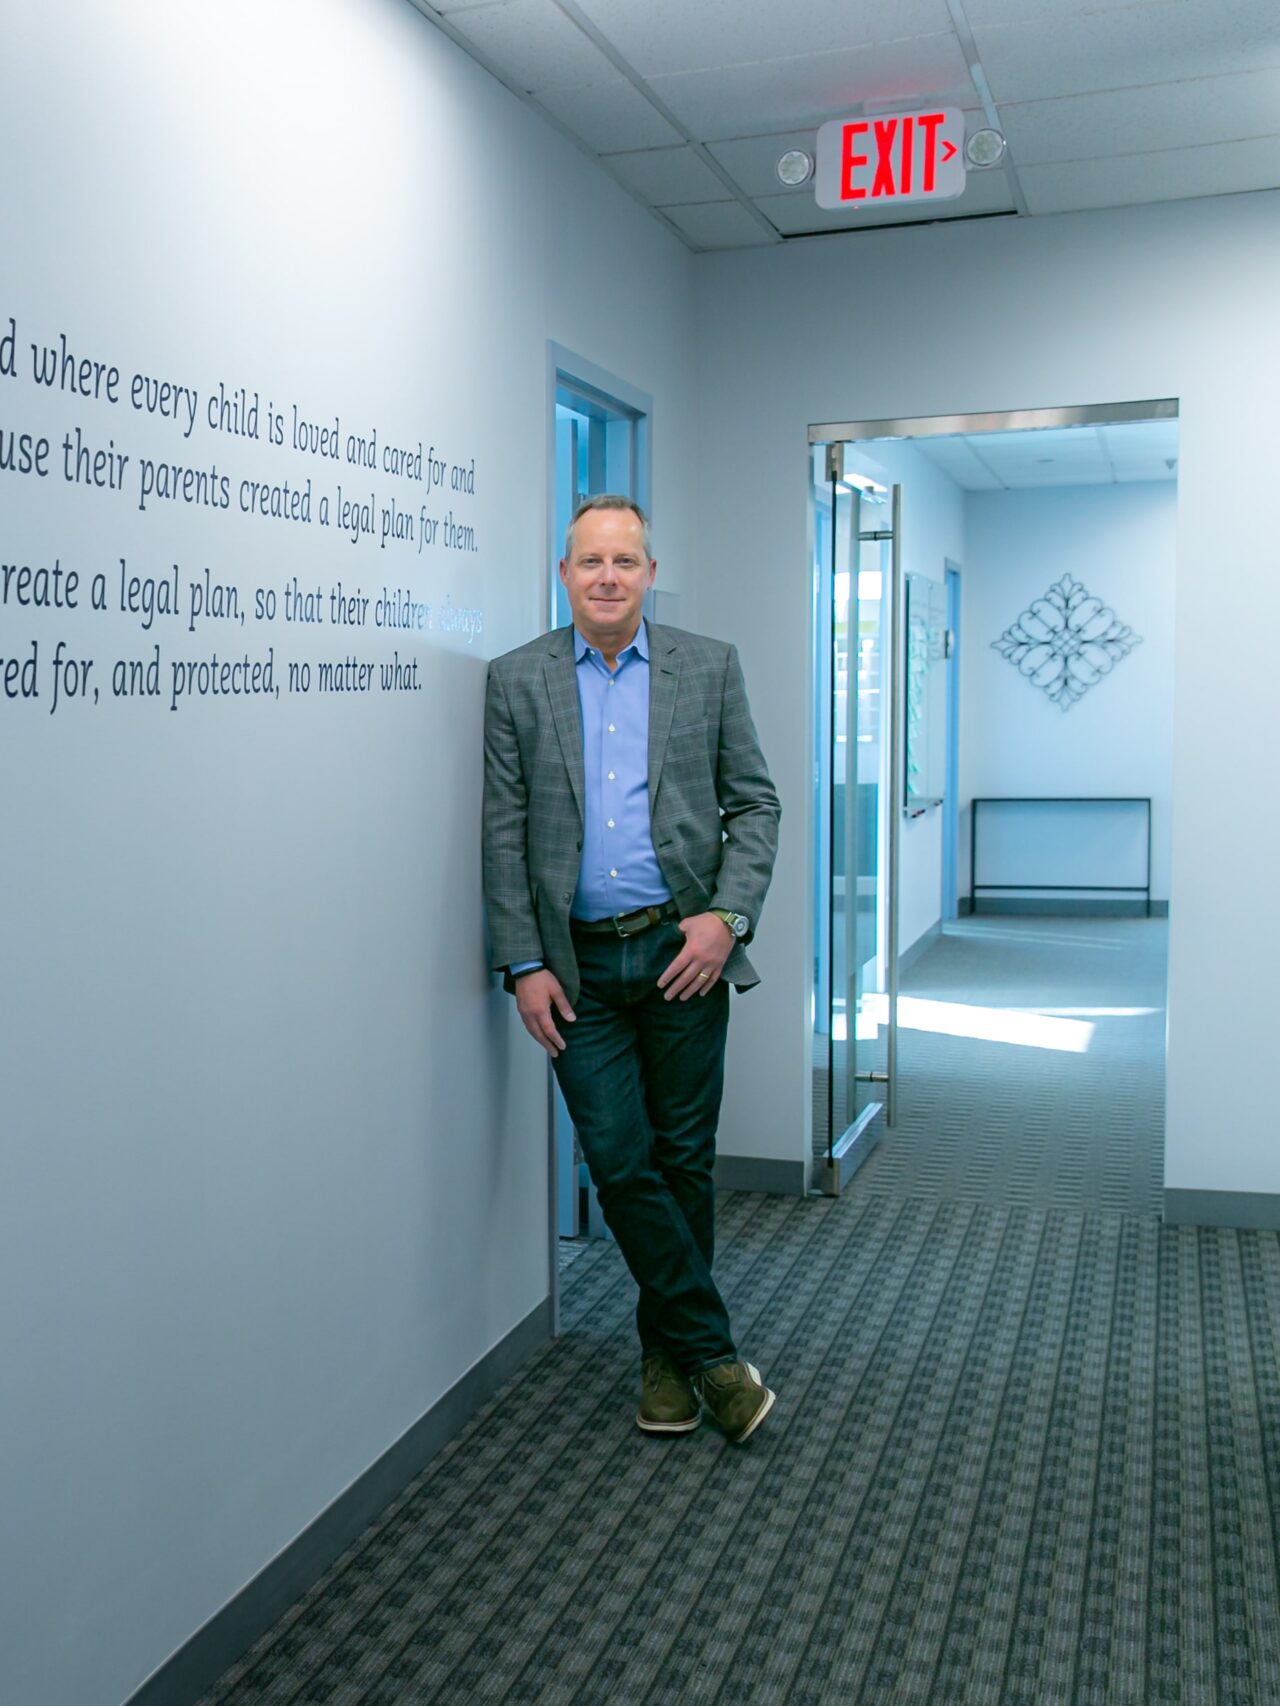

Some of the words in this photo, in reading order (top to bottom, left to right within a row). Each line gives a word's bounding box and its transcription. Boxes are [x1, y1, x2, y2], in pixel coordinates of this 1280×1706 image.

[841, 114, 945, 201] EXIT
[31, 333, 119, 403] where
[131, 374, 197, 438] every
[208, 382, 259, 440] child
[268, 402, 283, 446] is
[293, 404, 339, 460] loved
[347, 428, 376, 469] and
[383, 442, 422, 481] cared
[427, 447, 446, 495] for
[451, 459, 474, 495] and
[62, 427, 129, 490] their
[139, 459, 229, 511] parents
[240, 479, 311, 523] created
[319, 497, 329, 526] a
[337, 485, 375, 544] legal
[381, 498, 414, 549] plan
[418, 505, 438, 554] for
[444, 511, 478, 551] them.
[91, 574, 107, 610] a
[120, 558, 179, 630] legal
[189, 568, 244, 632] plan,
[255, 588, 276, 620] so
[285, 577, 322, 623] that
[330, 582, 369, 626] their
[375, 587, 433, 630] children
[50, 641, 99, 715] for,
[112, 644, 160, 696] and
[170, 647, 279, 711] protected,
[289, 663, 310, 692] no
[318, 656, 374, 692] matter
[380, 651, 421, 691] what.
